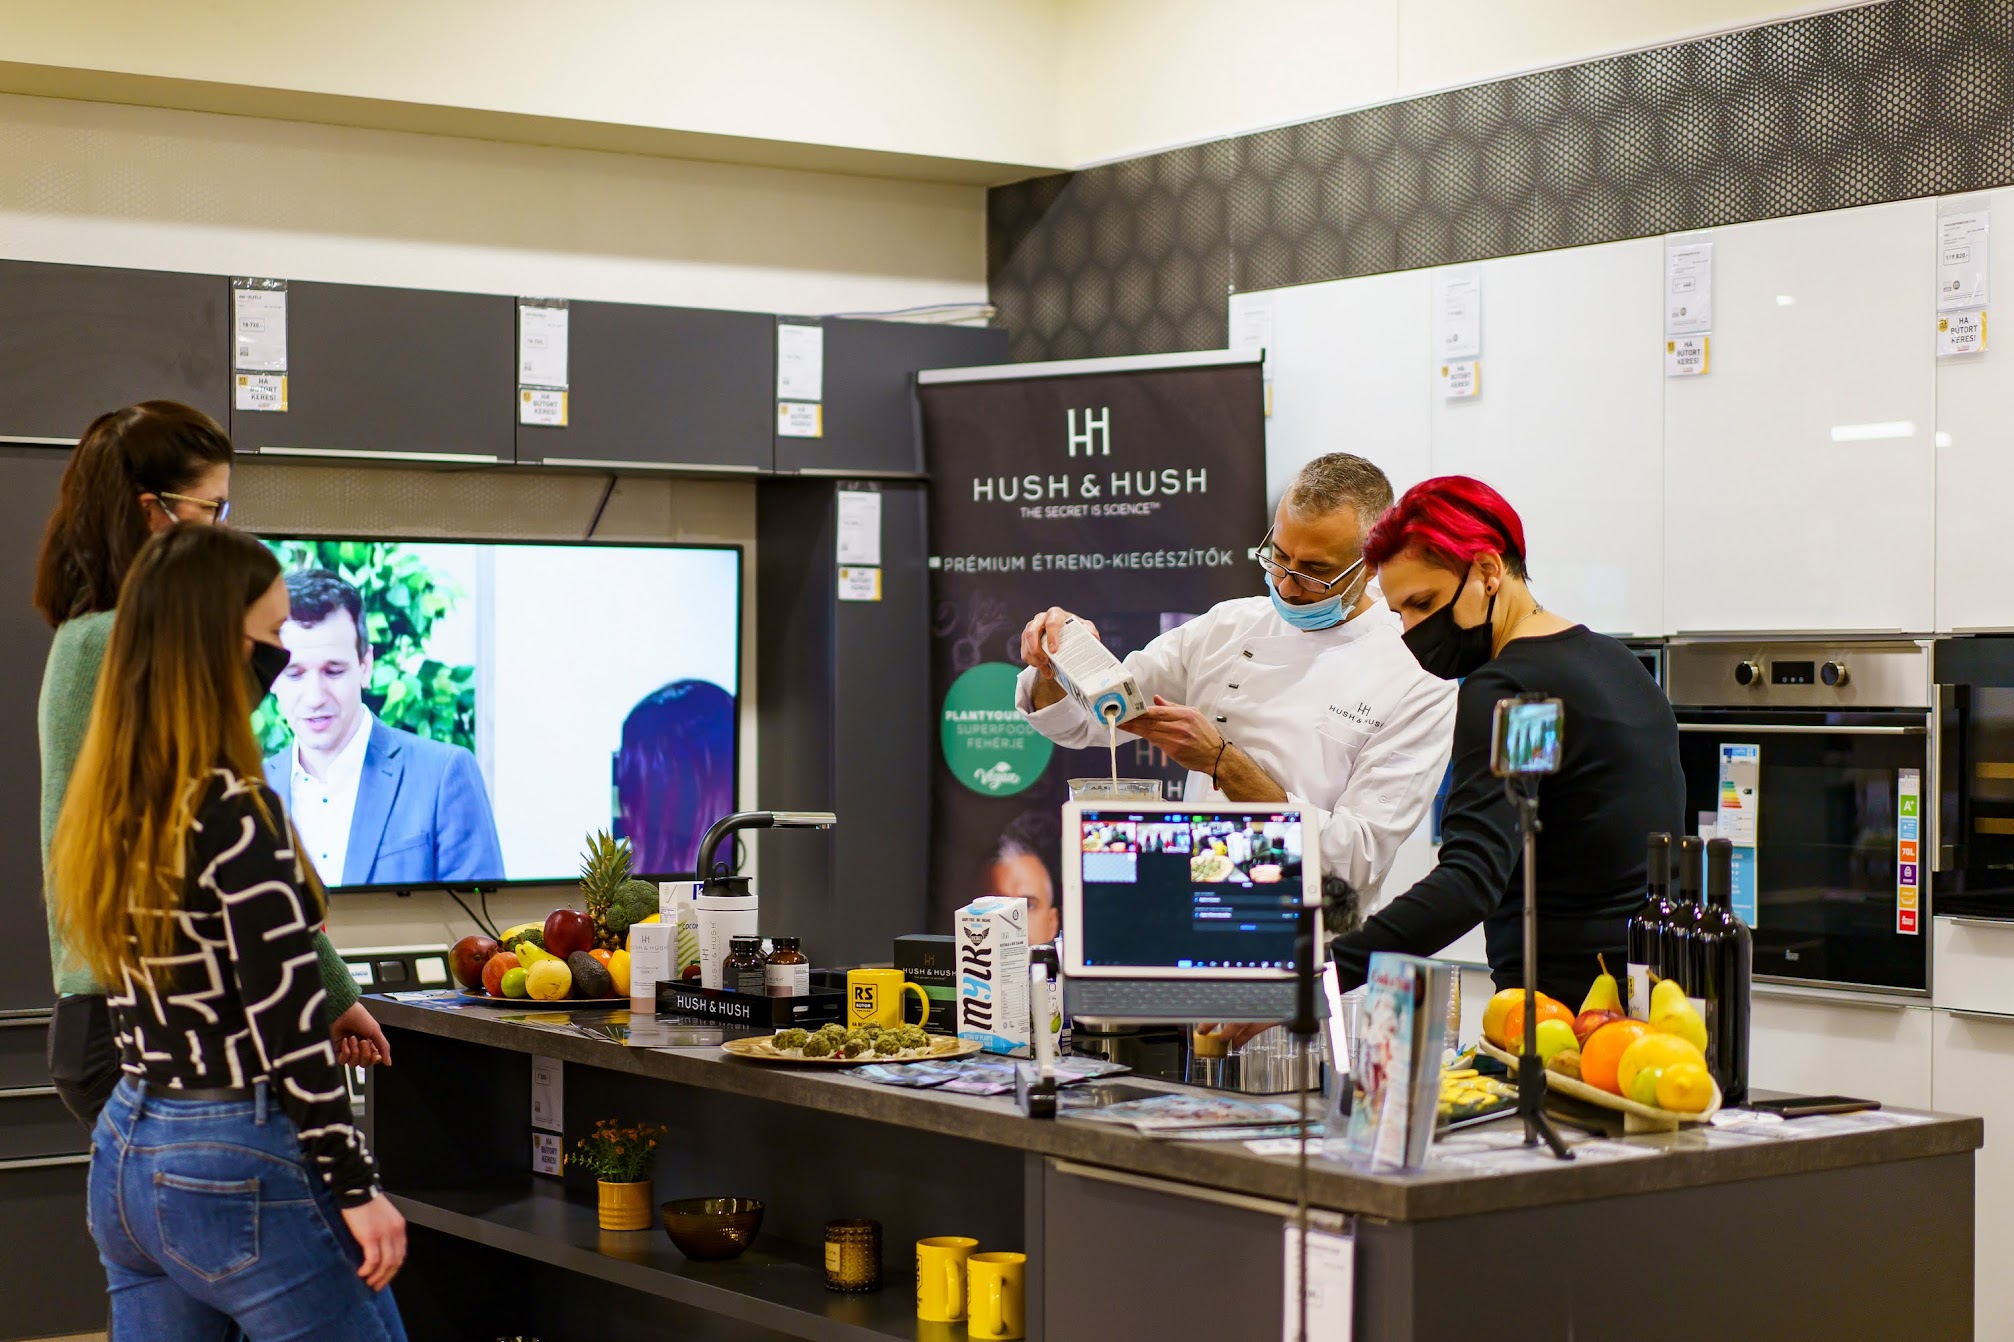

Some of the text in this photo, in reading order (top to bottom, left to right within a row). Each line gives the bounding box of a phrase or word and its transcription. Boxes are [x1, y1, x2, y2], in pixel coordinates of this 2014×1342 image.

[1958, 316, 1969, 324] HA
[1951, 335, 1977, 344] KERES!
[973, 467, 1208, 502] HUSH & HUSH
[1020, 506, 1043, 519] THE
[1045, 504, 1090, 518] SECRET
[1091, 504, 1101, 516] IS
[944, 547, 1233, 573] PRÉMIUM ÉTREND-KIEGÉSZÍTŐK
[945, 710, 1025, 722] PLANTYOUR
[1328, 704, 1355, 721] HUSH
[1902, 848, 1915, 856] 70L
[902, 967, 956, 977] HUSH & HUSH
[855, 987, 873, 1000] RS
[677, 995, 750, 1018] HUSH & HUSH
